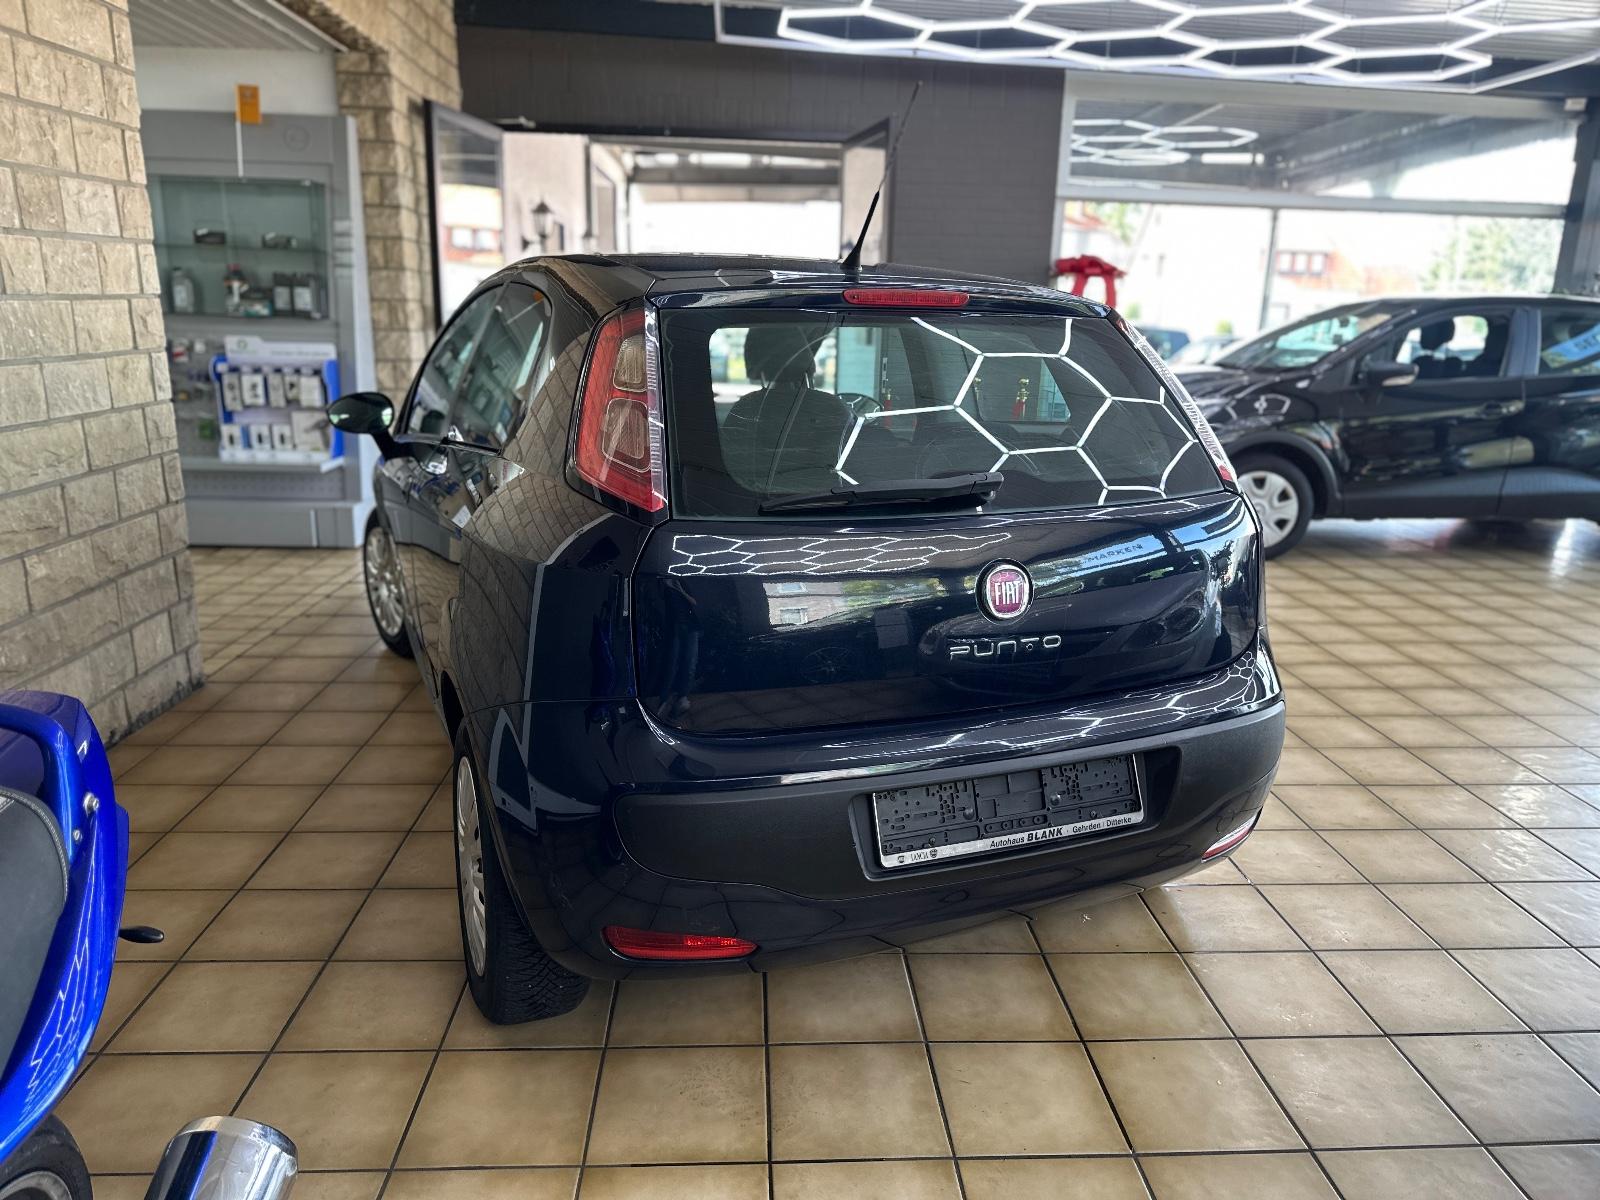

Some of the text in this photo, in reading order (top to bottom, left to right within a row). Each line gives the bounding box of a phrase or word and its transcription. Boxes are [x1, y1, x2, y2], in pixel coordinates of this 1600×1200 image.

[994, 580, 1022, 606] FIAT
[949, 635, 1062, 661] PUNTO
[989, 836, 1025, 848] Autohaus
[1026, 827, 1063, 842] BLANK
[1072, 822, 1101, 833] Gehrden
